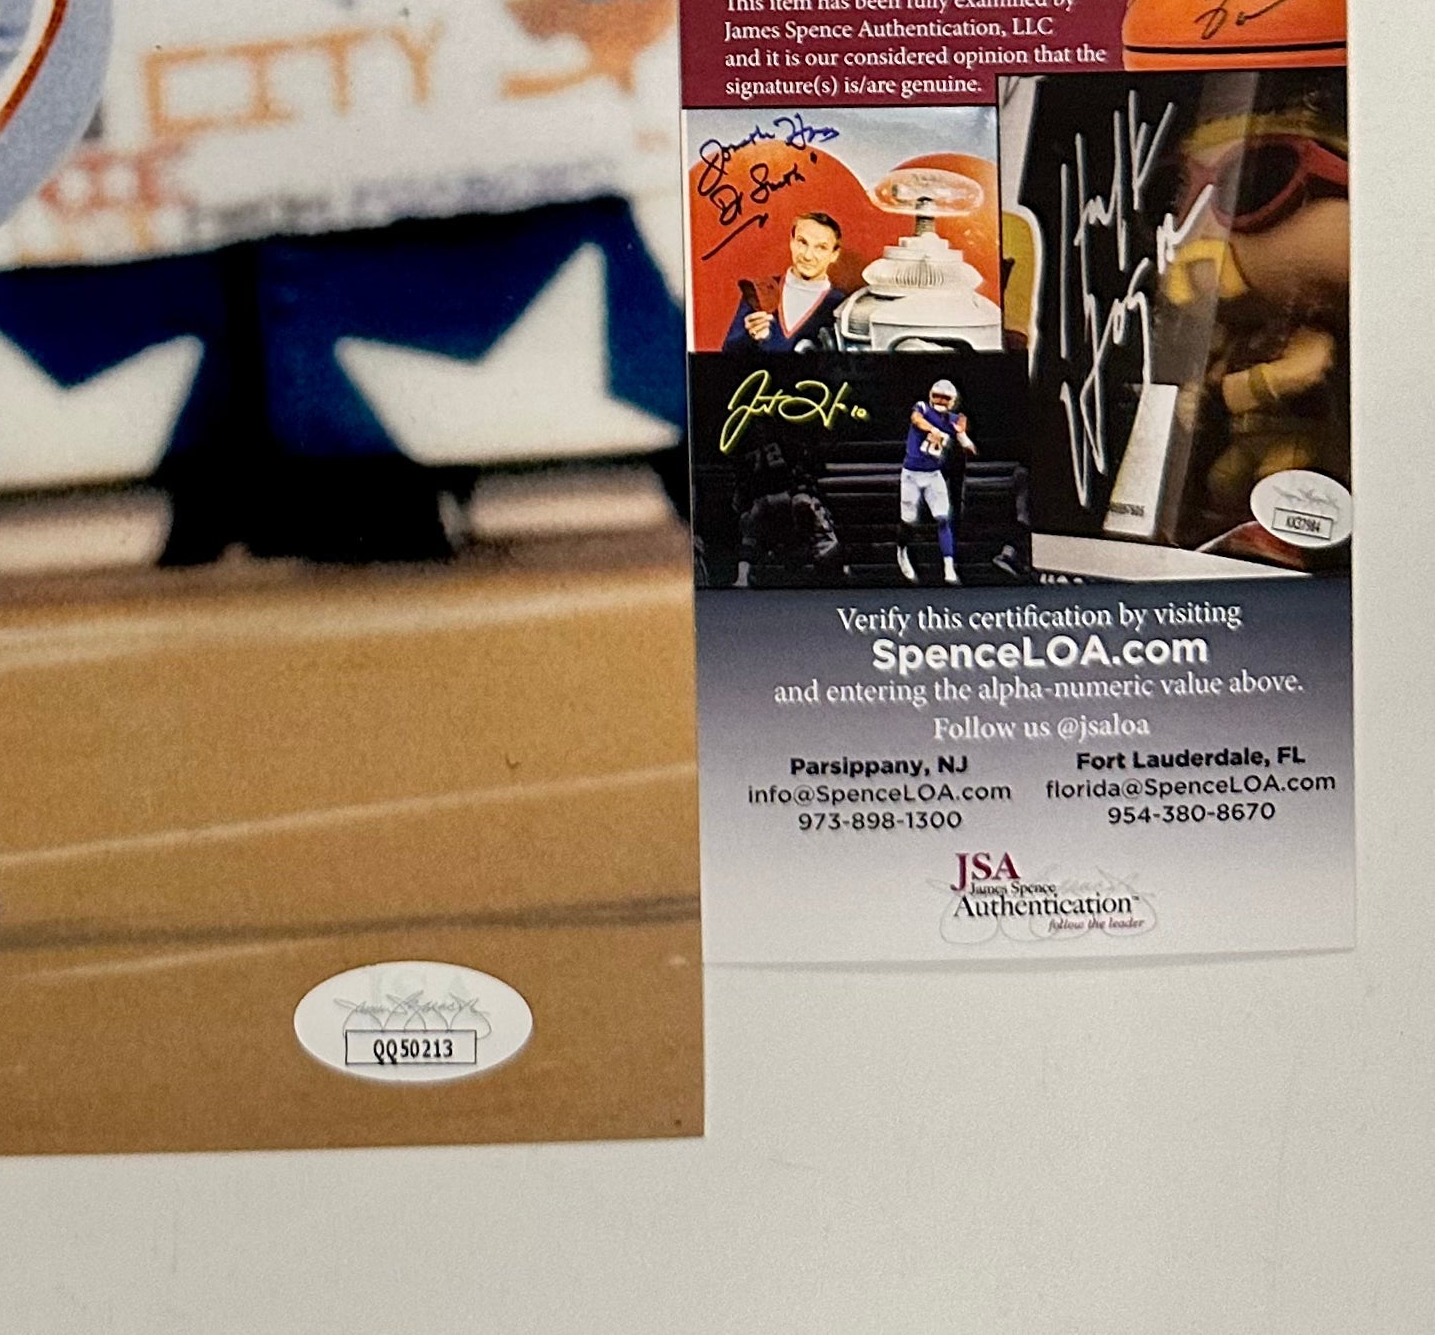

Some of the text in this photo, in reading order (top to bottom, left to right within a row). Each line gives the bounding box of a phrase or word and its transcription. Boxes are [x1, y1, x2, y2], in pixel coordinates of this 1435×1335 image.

[724, 17, 1054, 45] James Spence Authentication, LLC
[724, 42, 1108, 71] and it is our considered opinion that the
[142, 17, 448, 141] CITY
[724, 75, 984, 100] signature(s) is/are genuine.
[836, 601, 1243, 637] Verify this certification by visiting
[871, 634, 1209, 677] SpenceLOA.com
[773, 669, 1305, 710] and entering the alpha-numeric value above.
[933, 713, 1150, 744] Follow us @jsaloa
[789, 755, 969, 778] Parsippany, NJ
[1075, 746, 1306, 770] Fort Lauderdale, FL
[747, 783, 1012, 807] info@SpenceLOA.com
[1045, 773, 1336, 800] florida@SpenceLOA.com
[797, 810, 963, 831] 973-898-1300
[1107, 801, 1276, 825] 954-380-8670
[950, 851, 1021, 892] JSA
[968, 880, 1058, 896] James Spence
[1047, 915, 1146, 933] follow the leader
[372, 1038, 454, 1066] QQ50213
